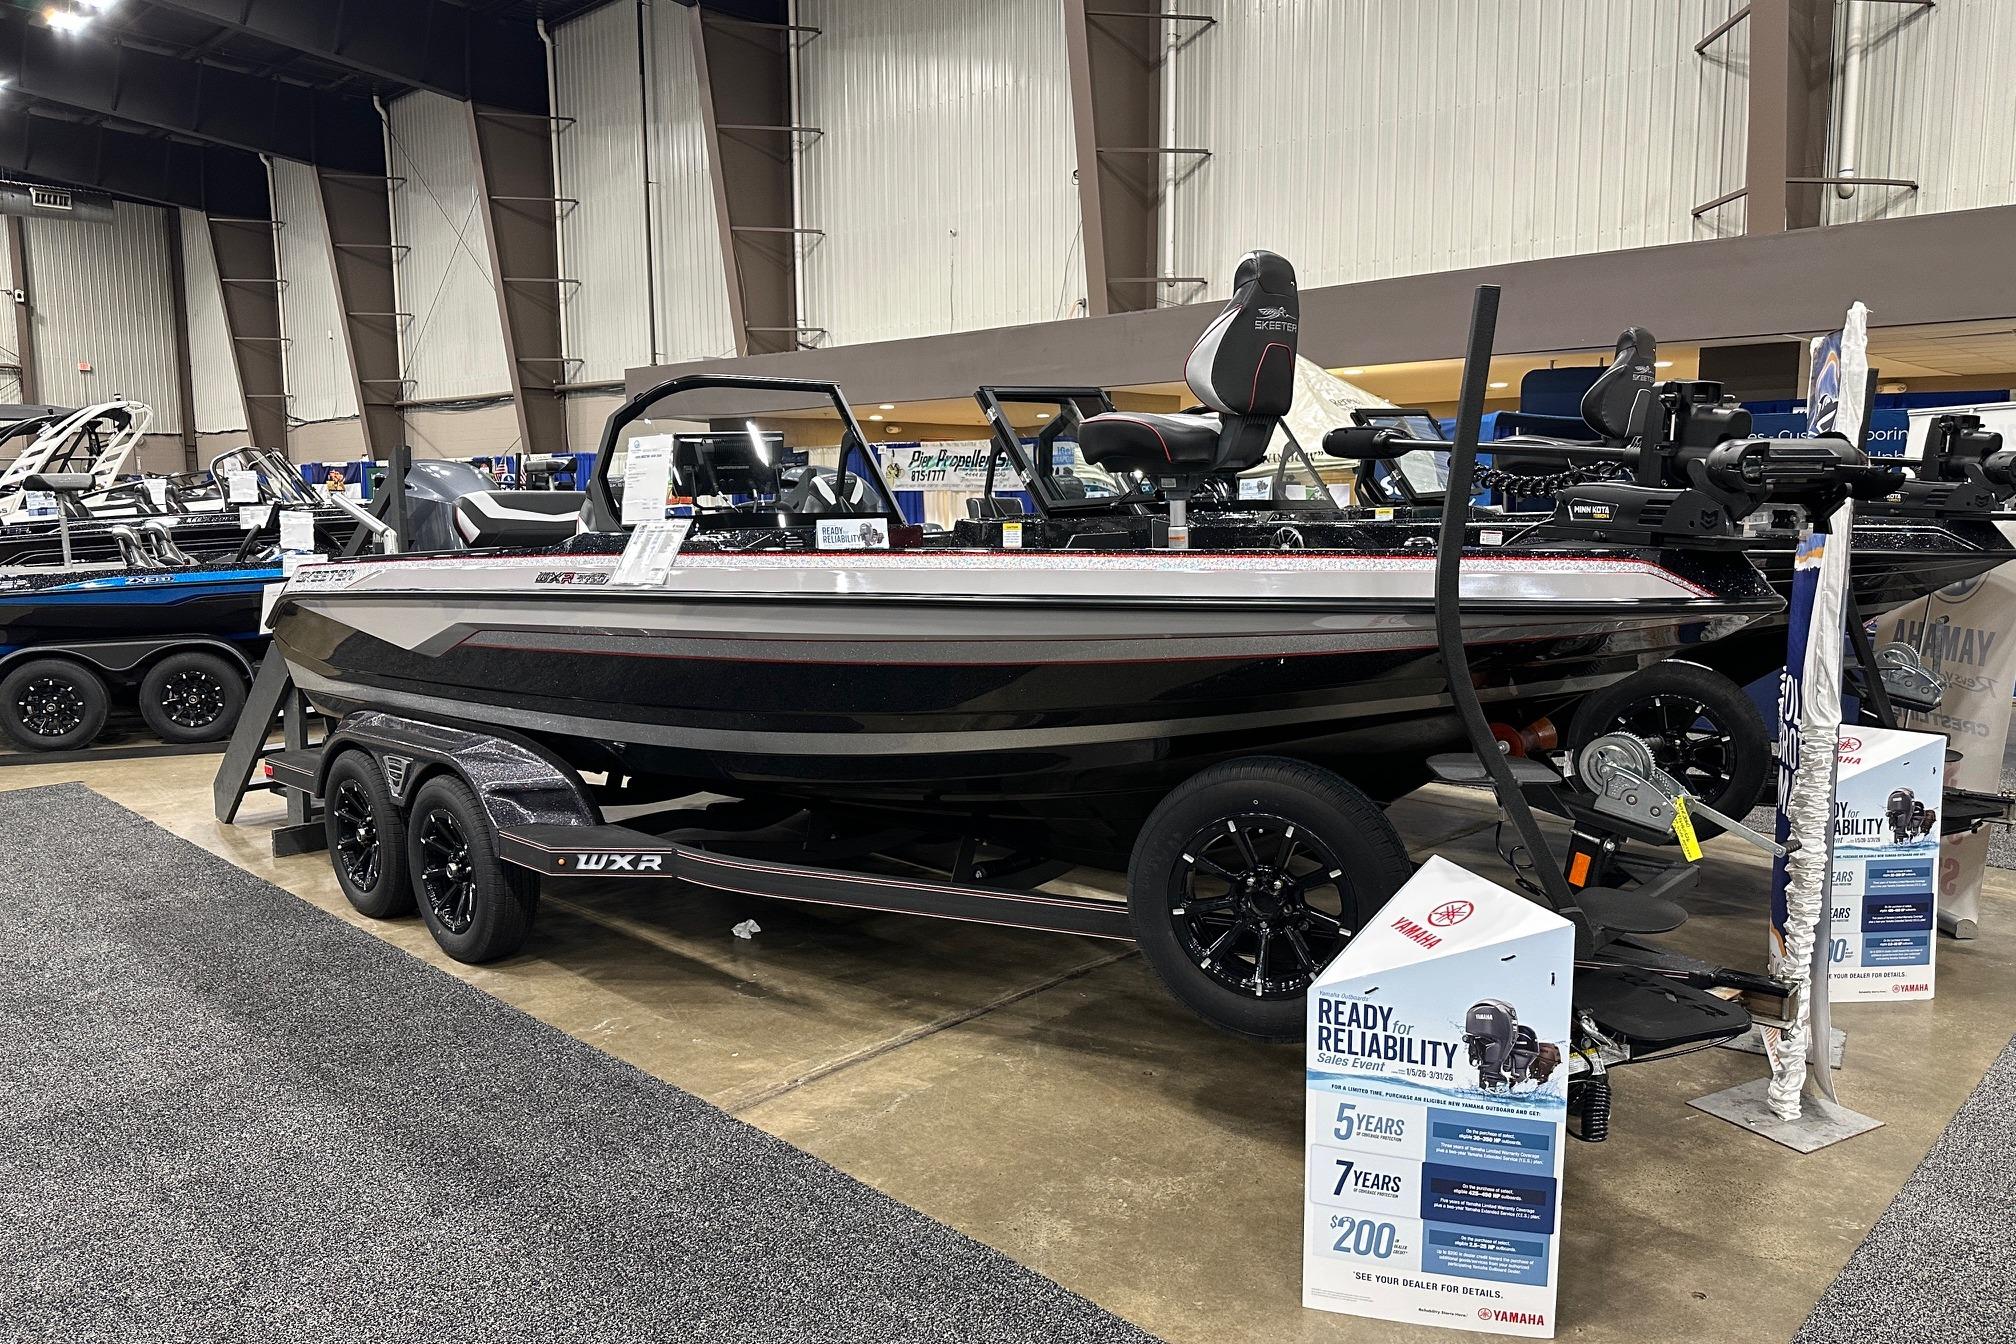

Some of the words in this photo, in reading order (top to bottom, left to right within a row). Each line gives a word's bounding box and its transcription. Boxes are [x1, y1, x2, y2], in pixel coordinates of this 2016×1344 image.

[1255, 320, 1297, 333] SKEETER
[1633, 374, 1655, 383] SKEETE
[1592, 506, 1610, 514] KOTA
[822, 526, 843, 535] READY
[823, 534, 861, 544] RELIABILITY
[1835, 818, 1884, 835] ABILITY
[576, 854, 662, 871] WXR
[1832, 871, 1853, 882] EARS
[1831, 908, 1851, 919] EARS
[1391, 917, 1443, 950] YAMAHA
[1901, 984, 1928, 992] YAMAHA
[1318, 998, 1393, 1032] READY
[1393, 1021, 1414, 1035] for
[1318, 1025, 1458, 1069] RELIABILITY
[1318, 1053, 1349, 1067] Sales
[1352, 1058, 1385, 1072] Event
[1386, 1092, 1413, 1100] PURCHASE
[1462, 1102, 1484, 1110] YAMAHA
[1486, 1105, 1515, 1114] OUTBOARD
[1334, 1103, 1356, 1140] 5
[1357, 1114, 1405, 1136] YEARS
[1334, 1159, 1354, 1196] 7
[1354, 1170, 1402, 1193] YEARS
[1330, 1215, 1396, 1259] $200
[1375, 1275, 1399, 1286] YOUR
[1403, 1279, 1438, 1290] DEALER
[1441, 1284, 1459, 1293] FOR
[1462, 1287, 1504, 1299] DETAILS.
[1494, 1310, 1544, 1326] YAMAHA
